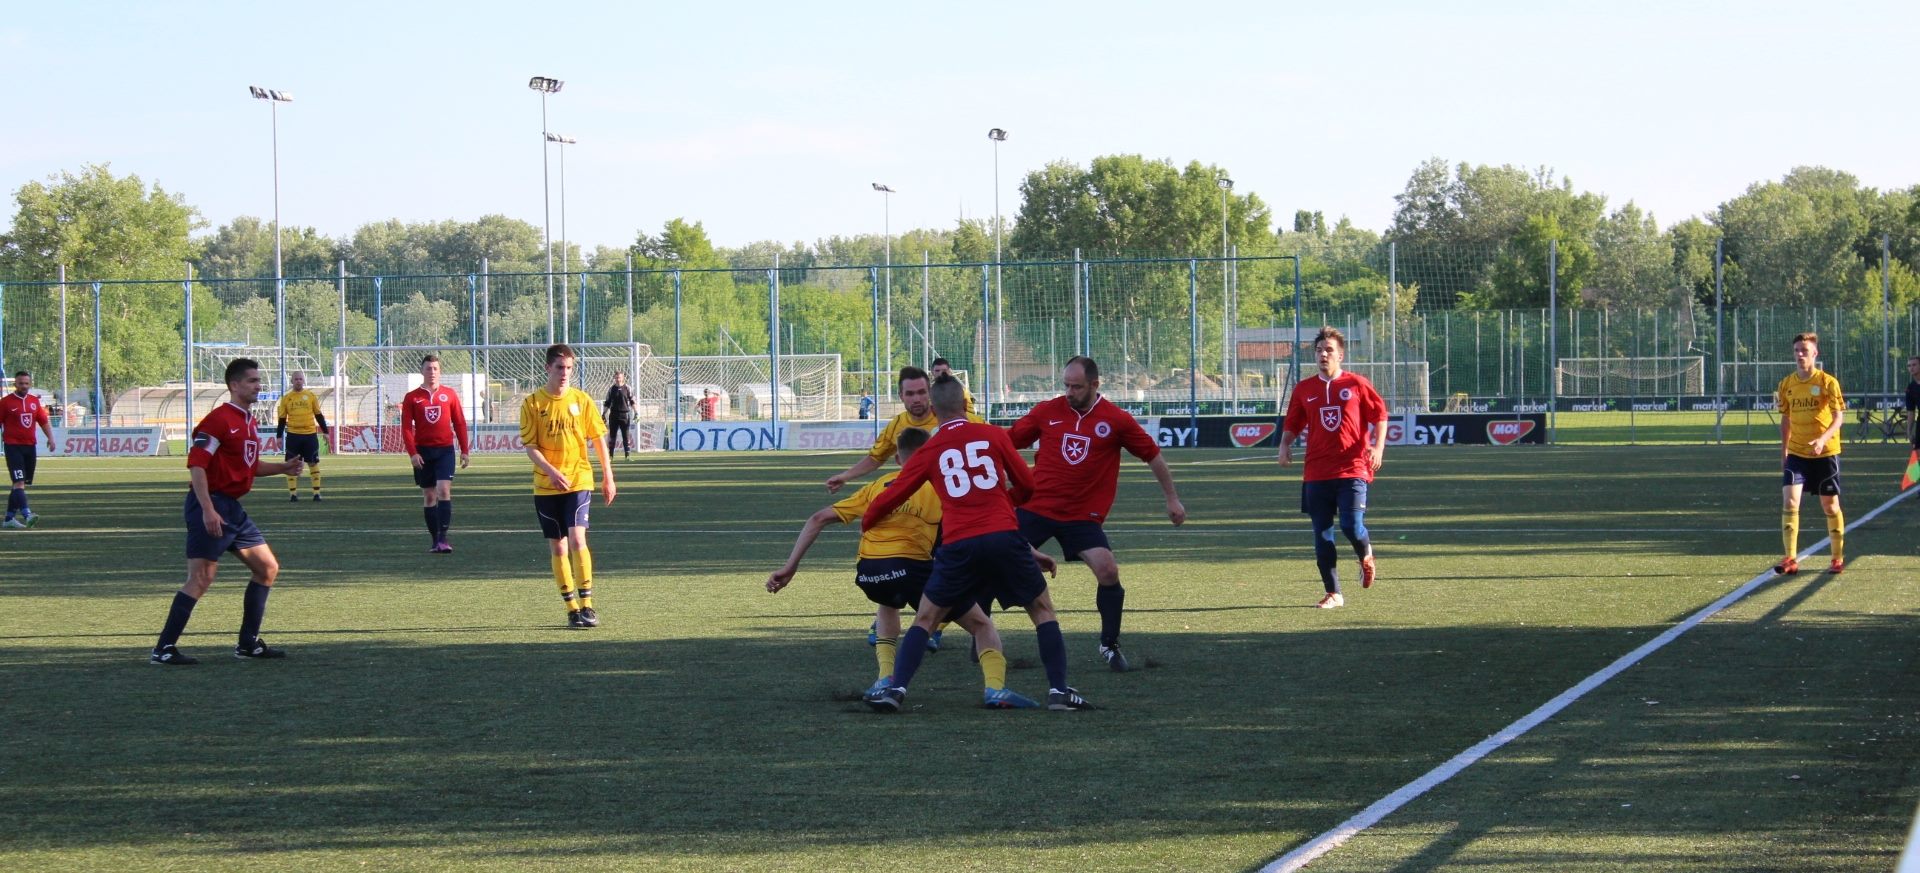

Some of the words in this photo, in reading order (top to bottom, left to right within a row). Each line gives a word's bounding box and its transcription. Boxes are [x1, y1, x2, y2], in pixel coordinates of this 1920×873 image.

[1572, 401, 1607, 412] market
[1632, 401, 1667, 411] market
[1236, 427, 1261, 437] MOL
[1415, 425, 1455, 445] GY!
[1493, 424, 1520, 435] MOL
[64, 437, 150, 453] STRABAG
[14, 469, 24, 480] 13
[939, 440, 999, 498] 85
[858, 569, 907, 584] akupac.hu
